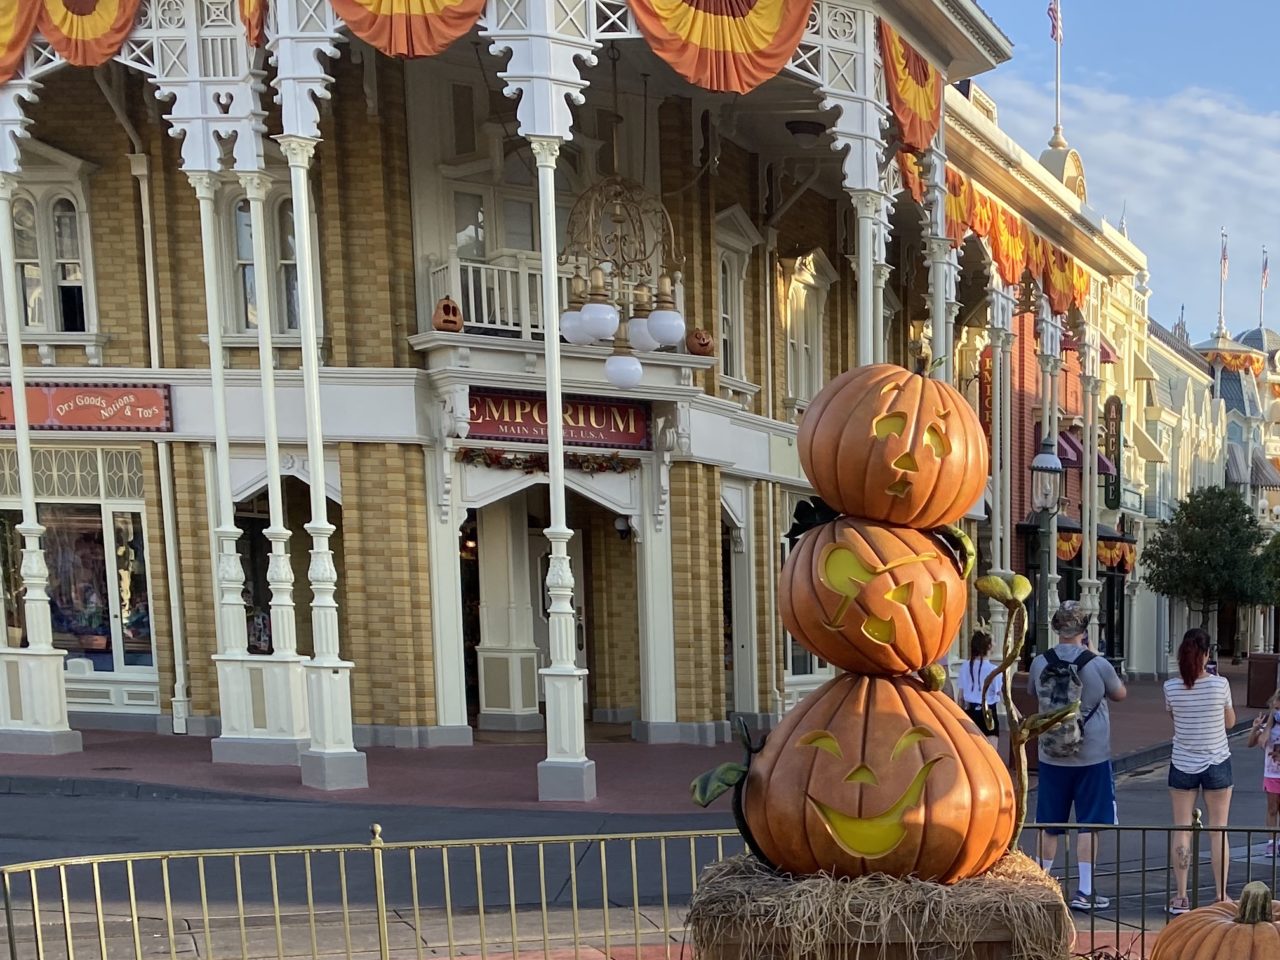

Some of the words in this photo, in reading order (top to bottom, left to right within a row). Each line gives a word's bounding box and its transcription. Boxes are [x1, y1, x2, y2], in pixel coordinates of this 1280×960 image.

[56, 400, 75, 417] Dry
[75, 394, 106, 408] Goods
[100, 394, 136, 420] Notions
[124, 405, 132, 417] &
[136, 405, 160, 418] Toys
[469, 396, 638, 434] EMPORIUM
[499, 424, 530, 435] MAIN
